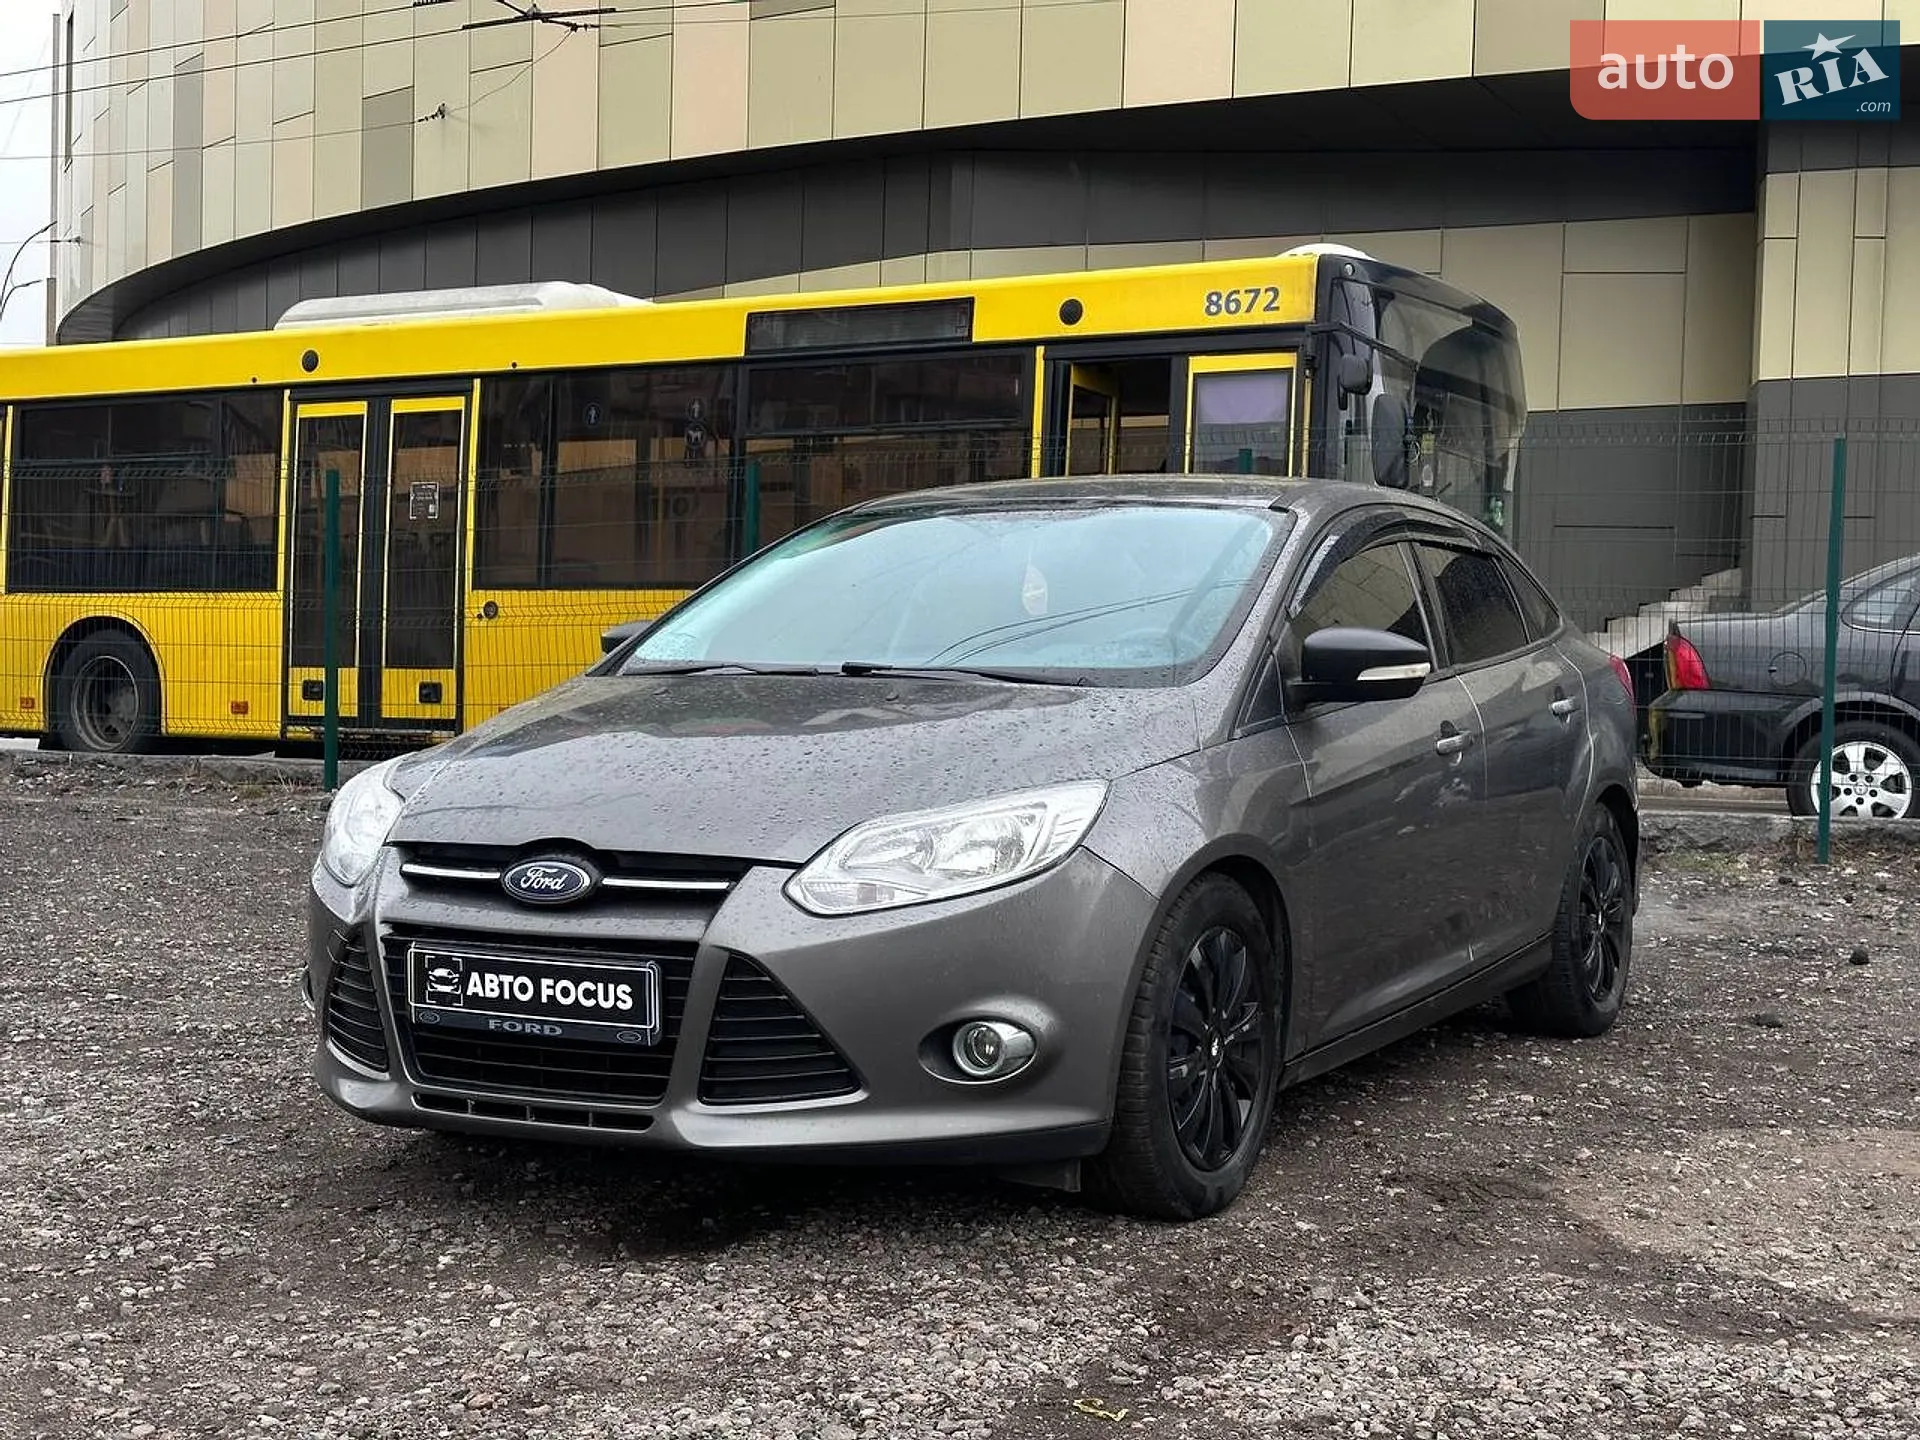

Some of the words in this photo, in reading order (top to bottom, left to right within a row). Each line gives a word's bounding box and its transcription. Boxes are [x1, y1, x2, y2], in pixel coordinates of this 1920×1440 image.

[1204, 286, 1280, 316] 8672
[519, 866, 568, 891] Ford
[466, 971, 534, 1002] АВТО
[540, 977, 634, 1011] FOCUS
[488, 1019, 563, 1036] FORD
